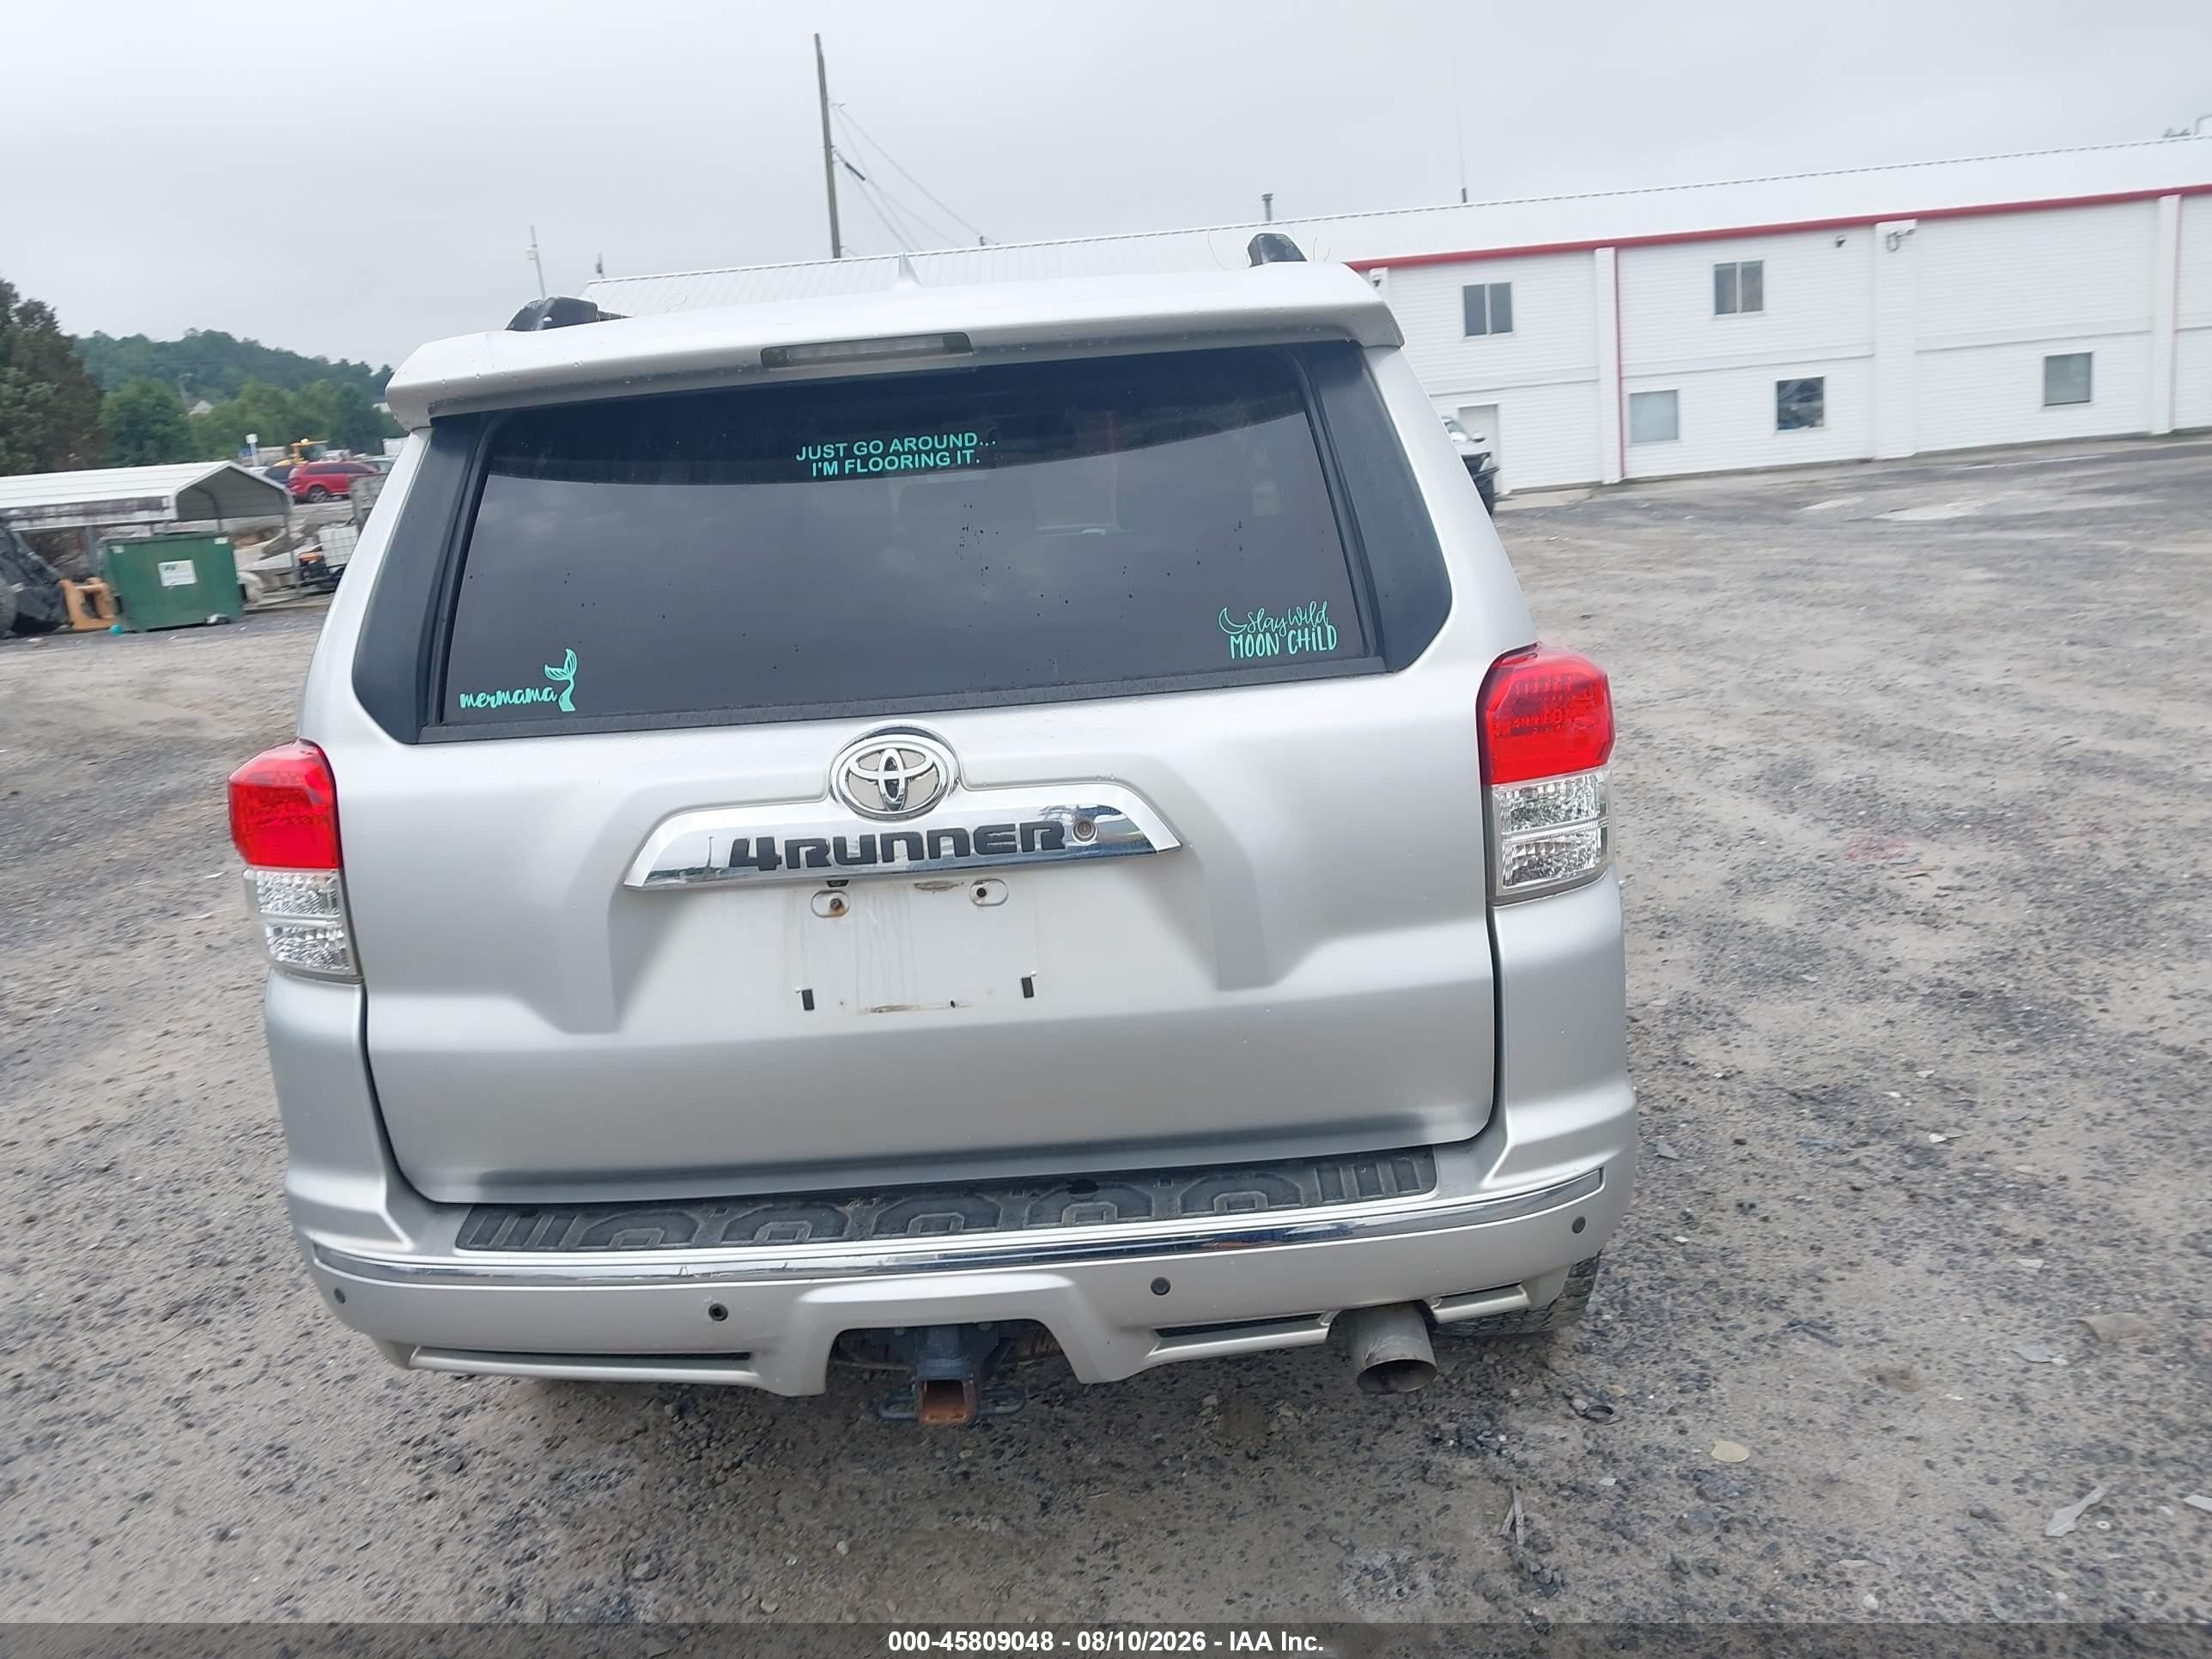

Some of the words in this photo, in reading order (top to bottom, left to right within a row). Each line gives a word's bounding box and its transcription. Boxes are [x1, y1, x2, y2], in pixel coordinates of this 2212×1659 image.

[795, 442, 848, 461] JUST
[853, 440, 884, 456] GO
[811, 460, 838, 477] I'M
[844, 451, 951, 474] FLOORING
[957, 449, 981, 465] IT.
[1230, 632, 1279, 659] MOON
[459, 687, 558, 708] mermama
[729, 820, 1066, 872] 4RUNNER
